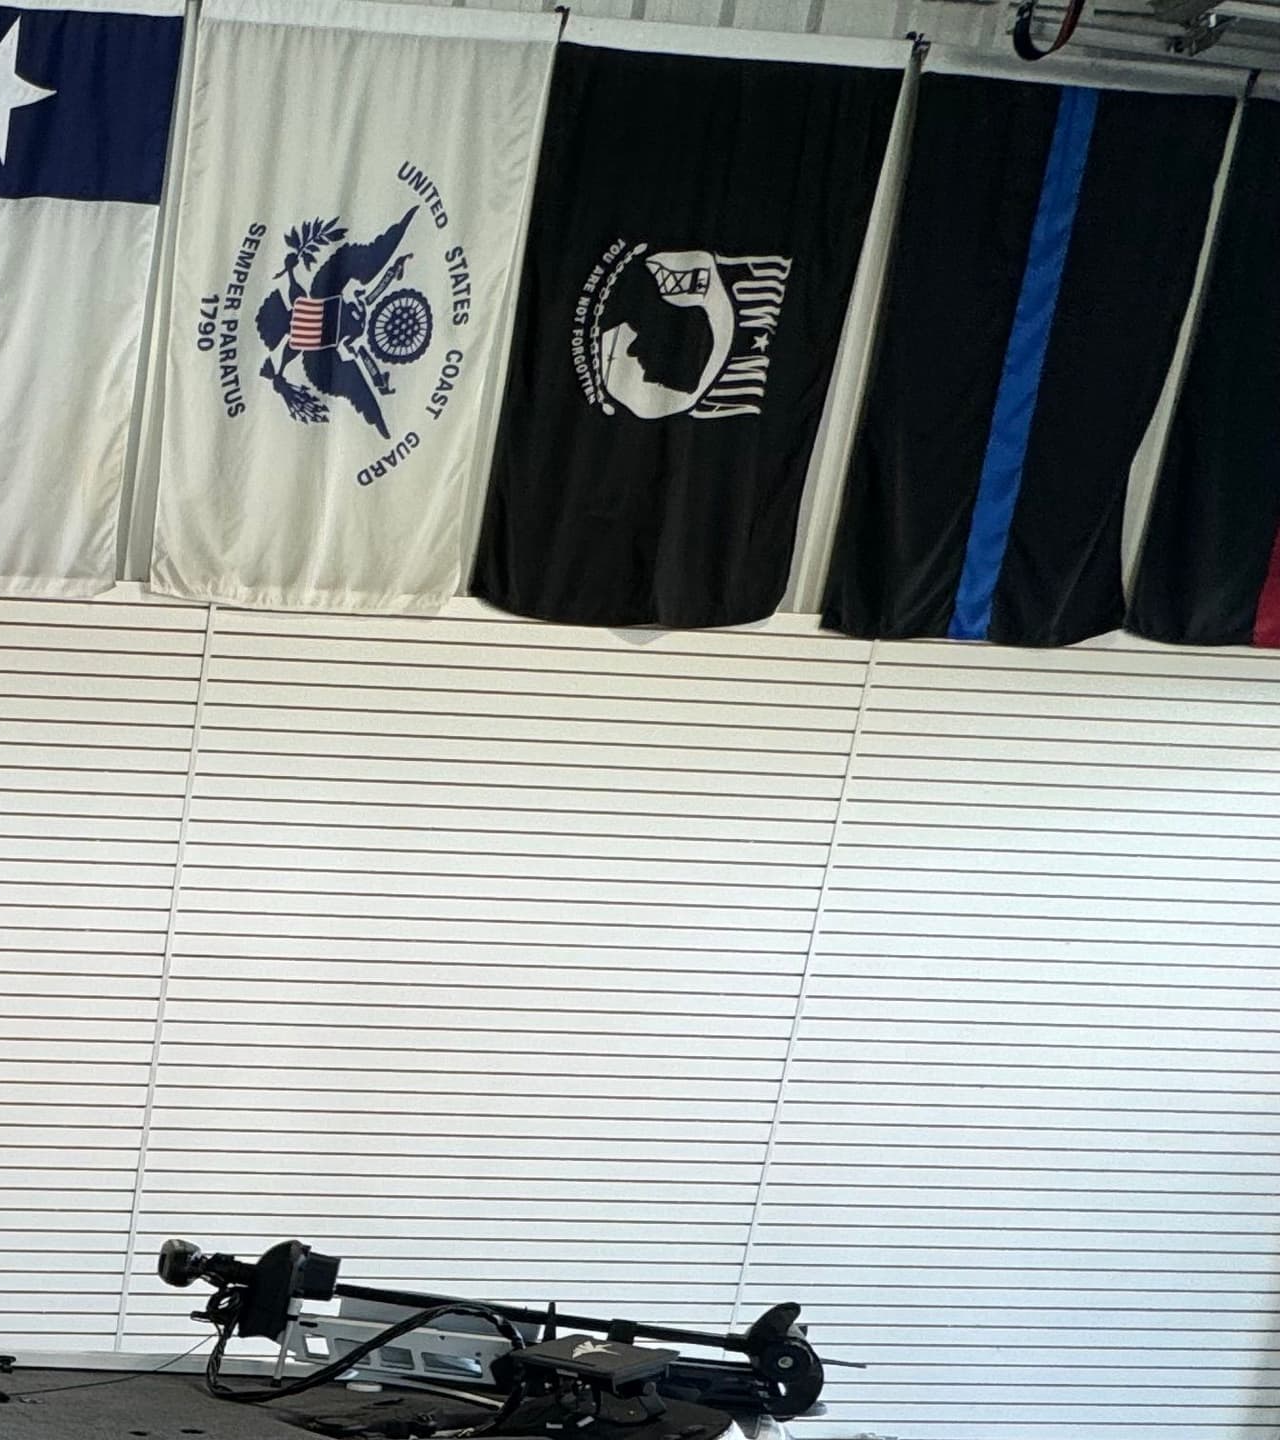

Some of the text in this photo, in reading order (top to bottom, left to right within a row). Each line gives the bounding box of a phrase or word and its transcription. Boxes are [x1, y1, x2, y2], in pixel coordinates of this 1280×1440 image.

[583, 265, 604, 293] ARE
[602, 238, 626, 264] YOU
[197, 293, 220, 352] 1790
[219, 222, 268, 419] SEMPER PARATUS
[357, 161, 471, 487] UNITED STATES COAST GUARD
[574, 297, 590, 324] NOT
[716, 255, 793, 335] POW
